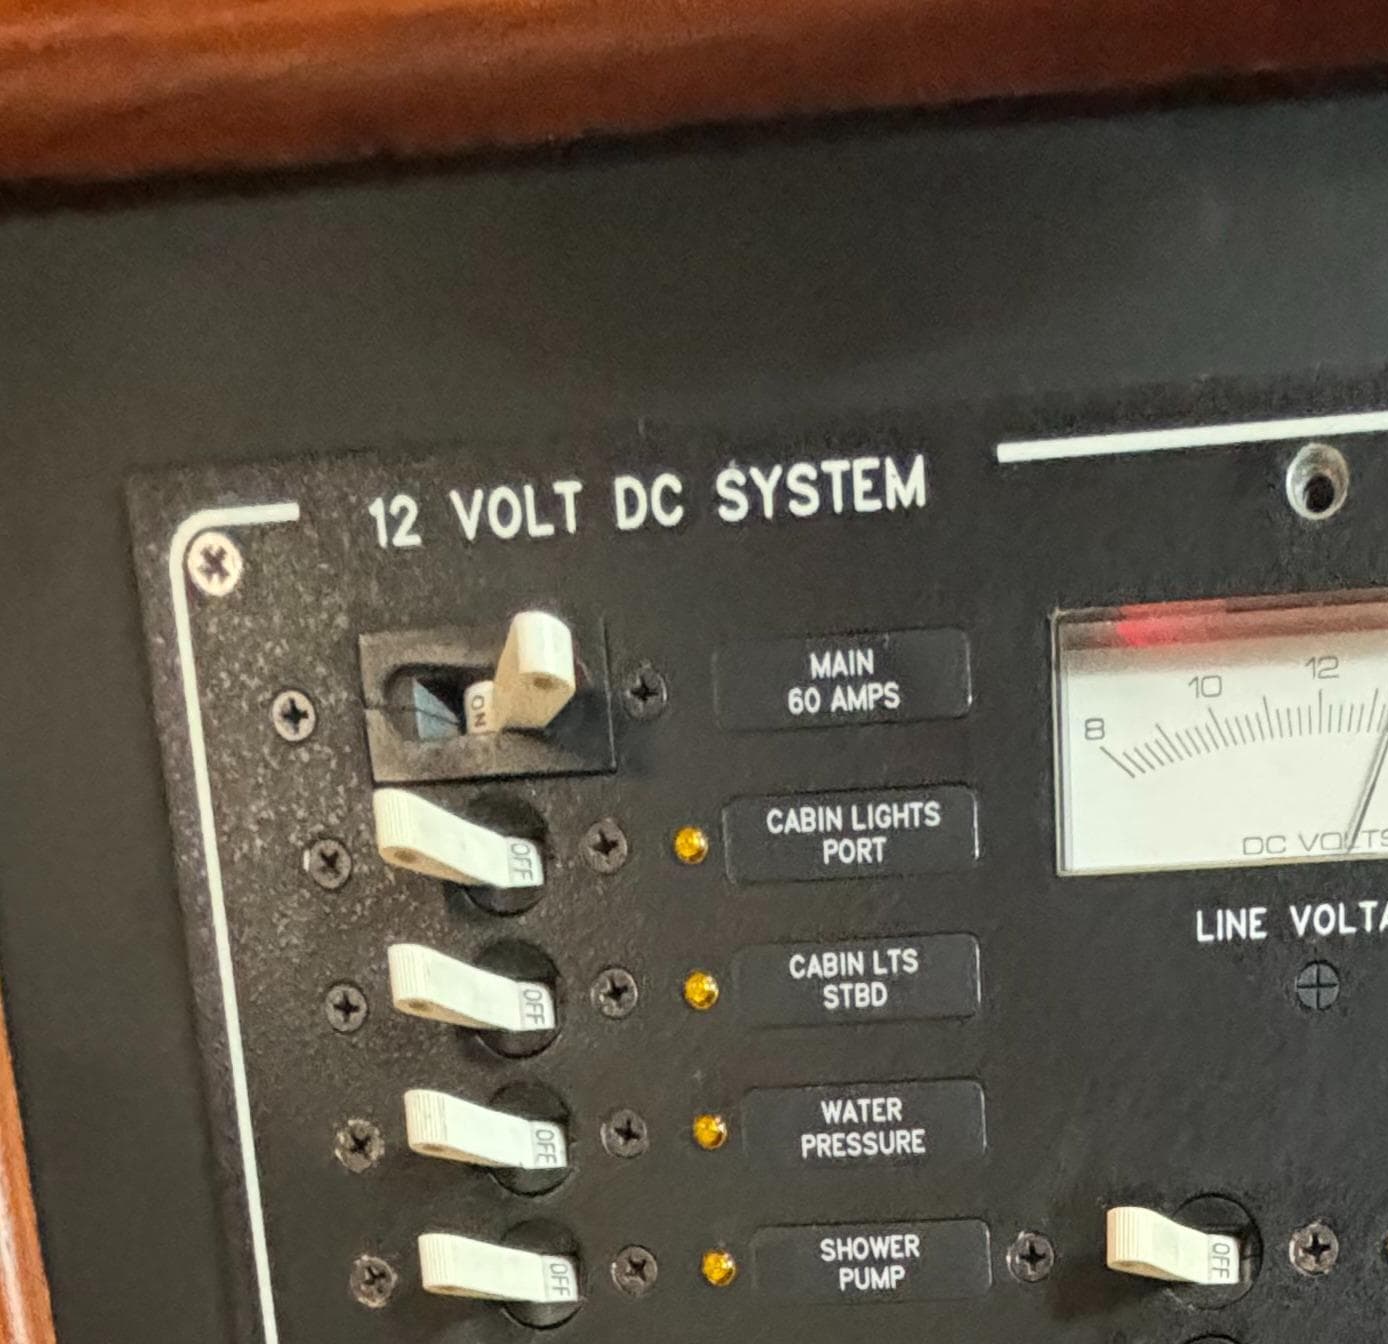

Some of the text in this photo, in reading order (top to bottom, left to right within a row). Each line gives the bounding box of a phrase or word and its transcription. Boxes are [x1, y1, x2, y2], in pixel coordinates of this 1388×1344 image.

[368, 454, 926, 548] 12 VOLT DC SYSTEM
[809, 648, 874, 679] MAIN
[1305, 655, 1339, 680] 12
[788, 681, 901, 715] 60 AMPS
[1188, 675, 1222, 698] 10
[471, 695, 486, 728] ON
[1084, 718, 1105, 741] 8
[766, 800, 941, 834] CABIN LIGHTS
[822, 836, 887, 865] PORT
[1242, 835, 1286, 856] DC
[508, 843, 535, 883] OFF
[1196, 906, 1268, 942] LINE
[789, 947, 919, 979] CABIN LTS
[522, 987, 545, 1025] OFF
[823, 981, 888, 1010] STBD
[820, 1097, 903, 1124] WATER
[801, 1128, 926, 1159] PRESSURE
[820, 1233, 920, 1262] SHOWER
[1212, 1242, 1231, 1279] OFF
[548, 1264, 571, 1298] OFF
[839, 1264, 906, 1291] PUMP
